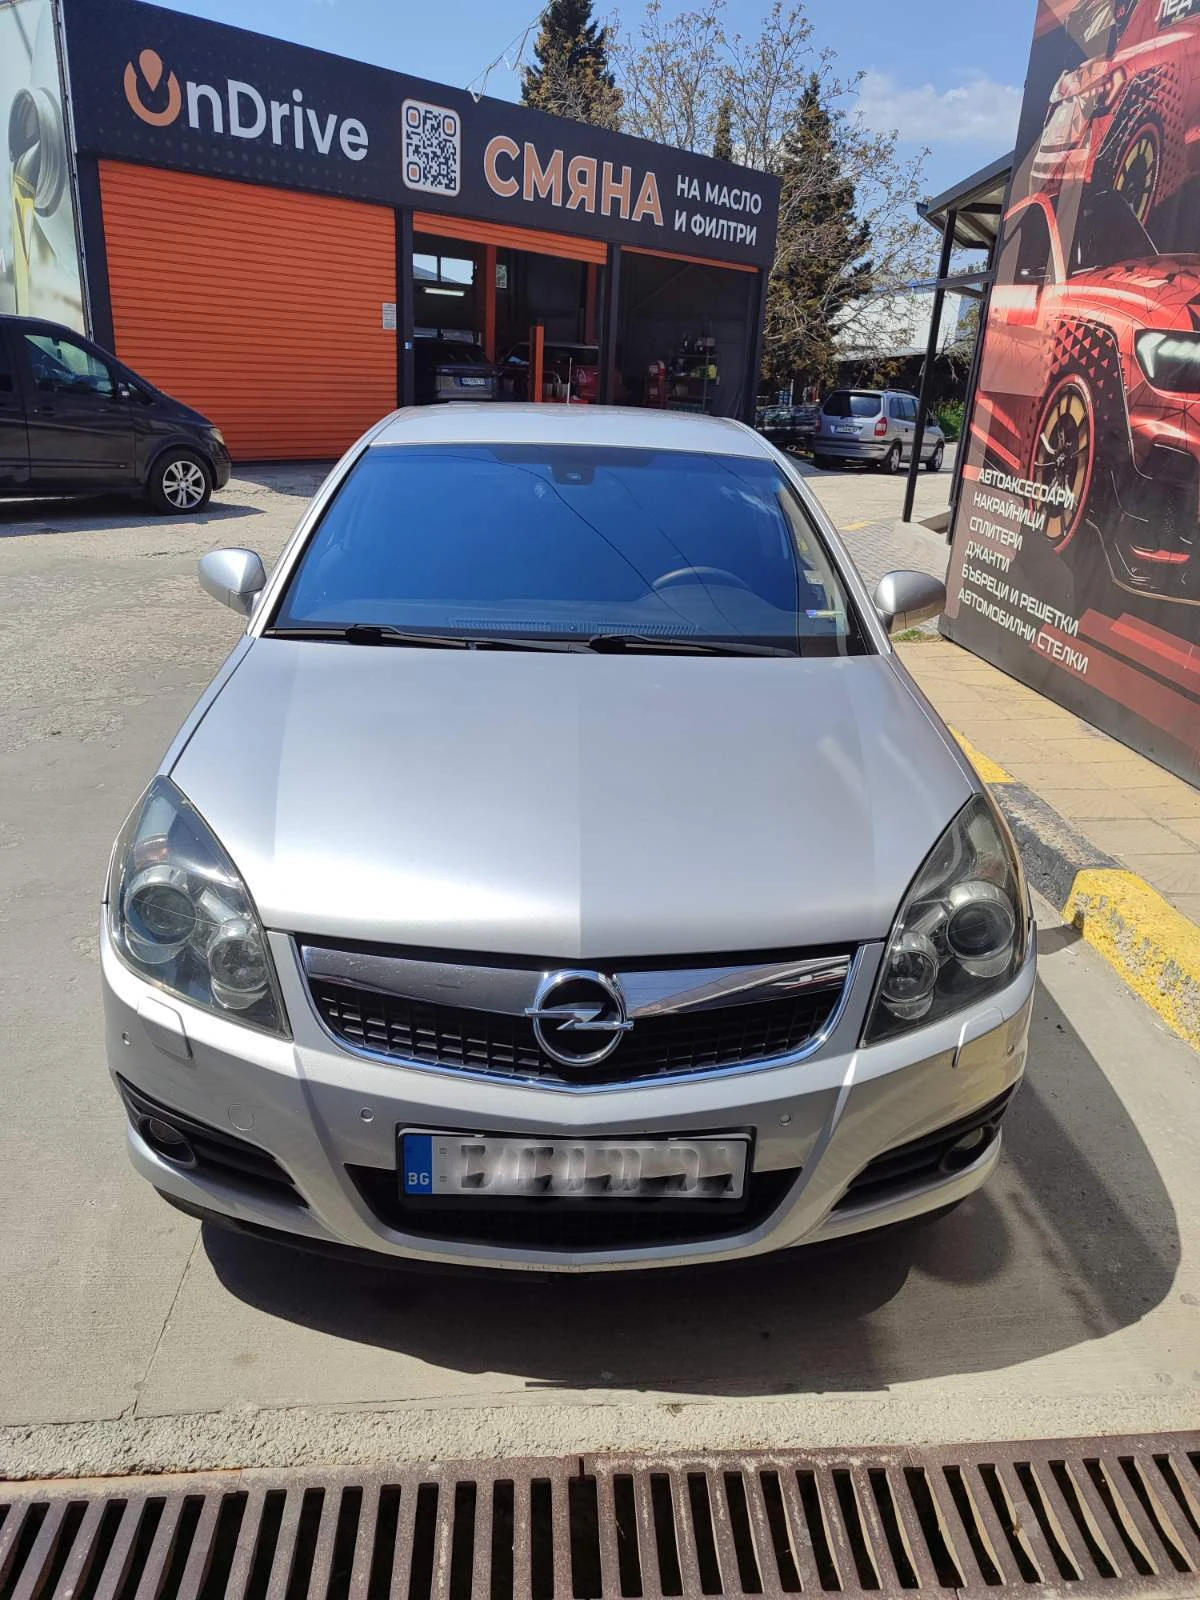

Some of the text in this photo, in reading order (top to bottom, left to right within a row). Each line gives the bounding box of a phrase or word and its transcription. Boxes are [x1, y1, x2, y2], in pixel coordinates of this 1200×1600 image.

[483, 135, 664, 227] СМЯНА
[676, 174, 763, 215] НА МАСЛО
[674, 209, 758, 247] И ФИЛТРИ
[977, 467, 1076, 511] АВТОАКСЕСОАРИ
[972, 491, 1046, 532] НАКРАЙНИЦИ
[969, 516, 1024, 551] СПЛИТЕРИ
[964, 540, 1011, 574] ДЖАНТИ
[961, 563, 1080, 637] БЪБРЕЦИ И РЕШЕТКИ
[957, 587, 1090, 675] АВТОМОБИЛНИ СТЕЛКИ
[408, 1172, 430, 1186] BG
